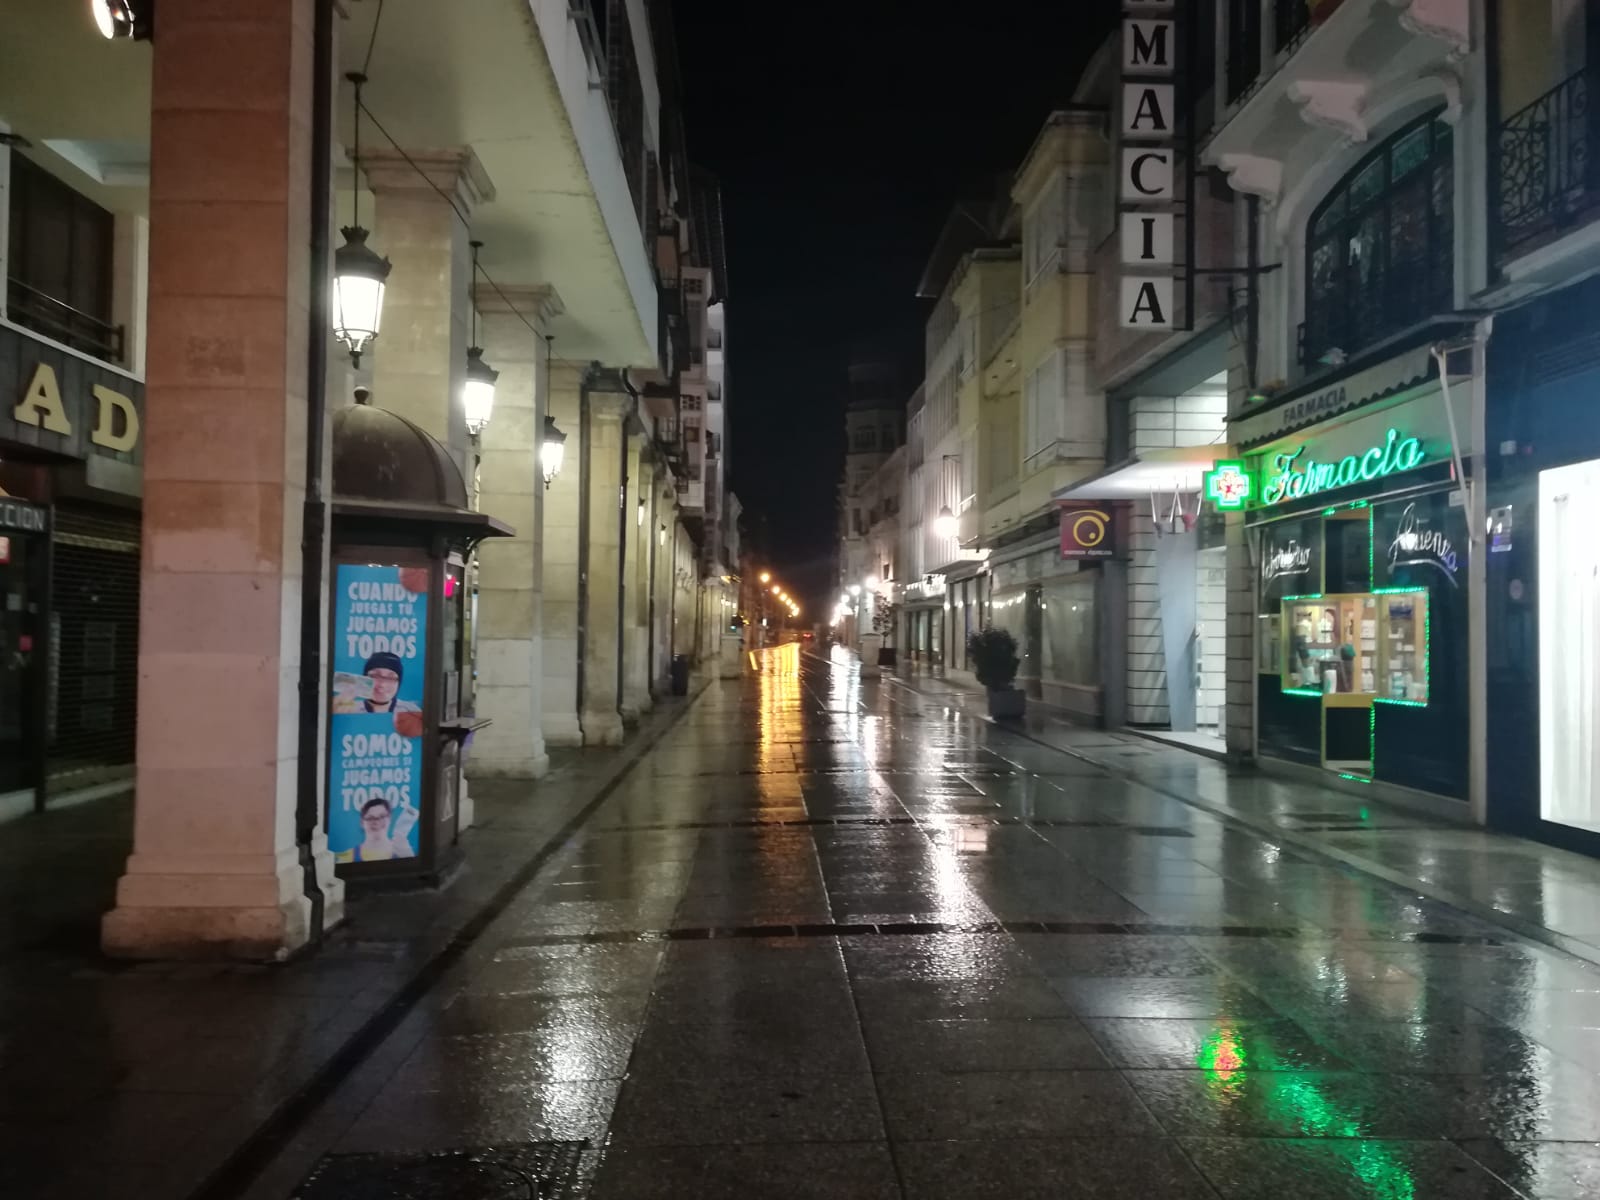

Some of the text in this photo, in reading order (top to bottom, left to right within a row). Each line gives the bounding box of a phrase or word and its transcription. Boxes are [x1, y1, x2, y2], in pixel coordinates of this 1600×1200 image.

[1130, 0, 1169, 324] MACIA
[1283, 386, 1348, 424] FARMACIA
[1264, 428, 1425, 505] Farmacia
[0, 503, 45, 532] CION
[349, 602, 393, 615] JUEGAS
[346, 616, 418, 634] JUGAMOS
[346, 634, 417, 659] TODOS
[341, 732, 413, 757] SOMOS
[342, 757, 400, 769] CAMPEONES
[341, 767, 411, 787] JUGAMOS
[341, 785, 411, 812] TODOS
